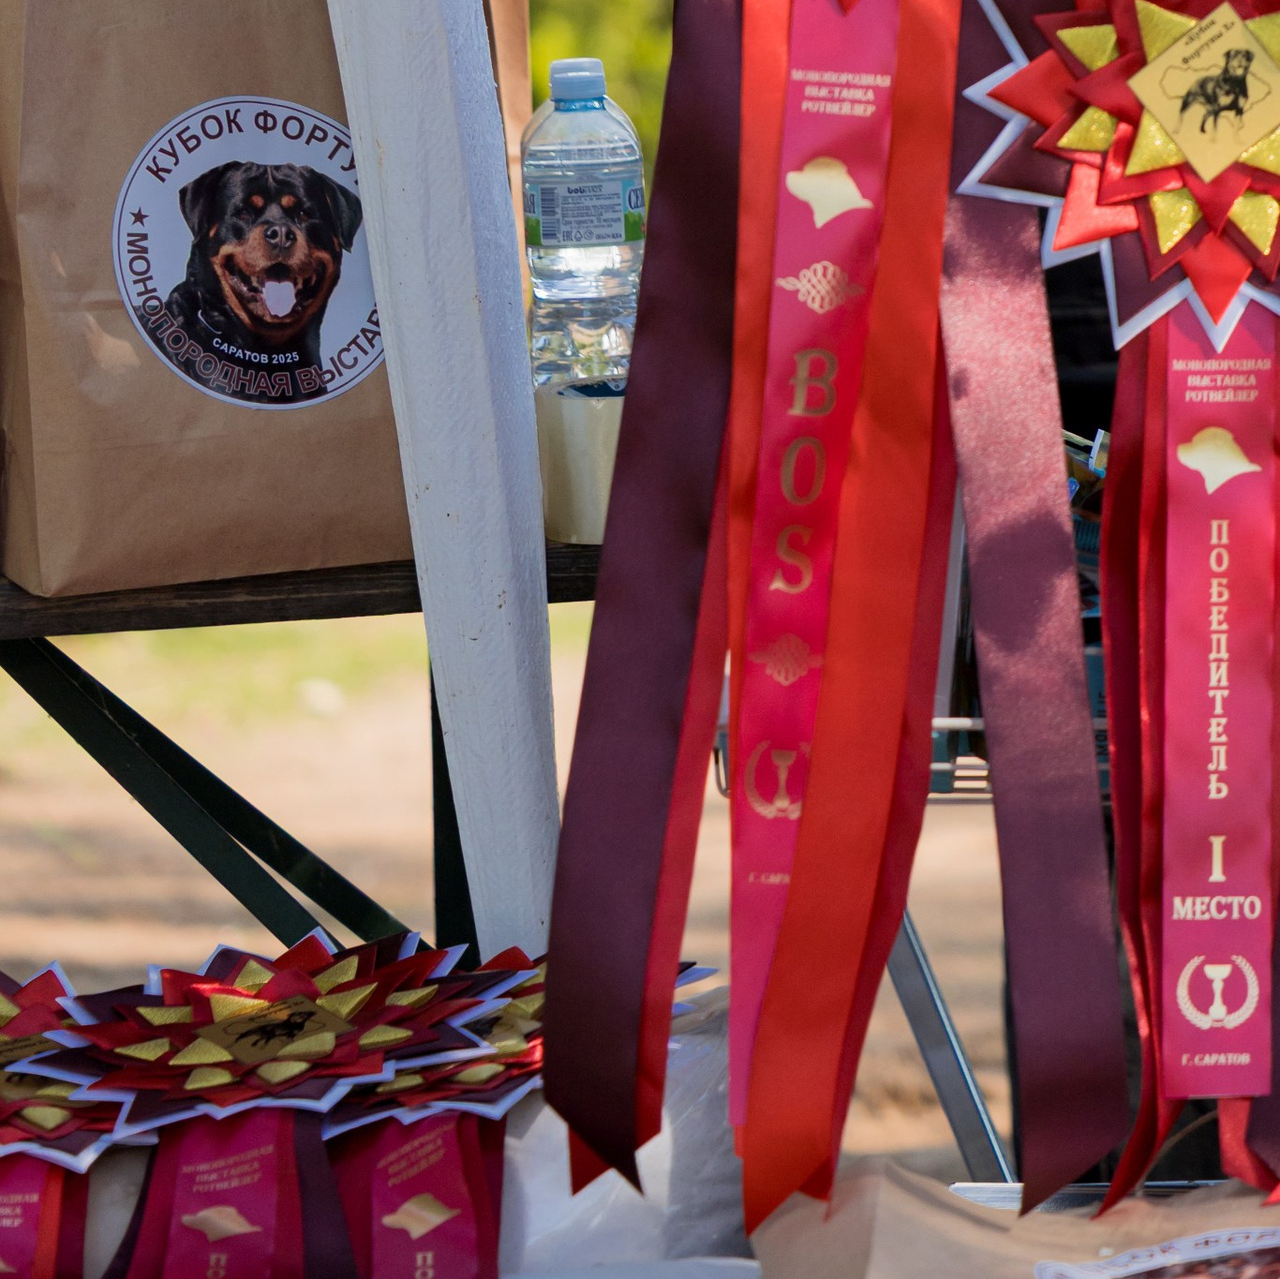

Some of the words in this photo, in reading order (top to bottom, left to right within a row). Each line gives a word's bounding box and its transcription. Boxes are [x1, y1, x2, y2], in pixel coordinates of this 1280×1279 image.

[146, 108, 244, 183] КУБОК
[254, 110, 358, 185] ФОРТ
[126, 232, 291, 396] МОНОПОРОДНАЯ
[297, 302, 382, 395] ВЫСТАВ
[213, 338, 269, 364] САРАТОВ
[272, 351, 300, 364] 2025
[1207, 519, 1230, 800] ПОБЕДИТЕЛЬ
[1172, 895, 1261, 921] МЕСТО
[1189, 1053, 1251, 1067] САРАТОВ
